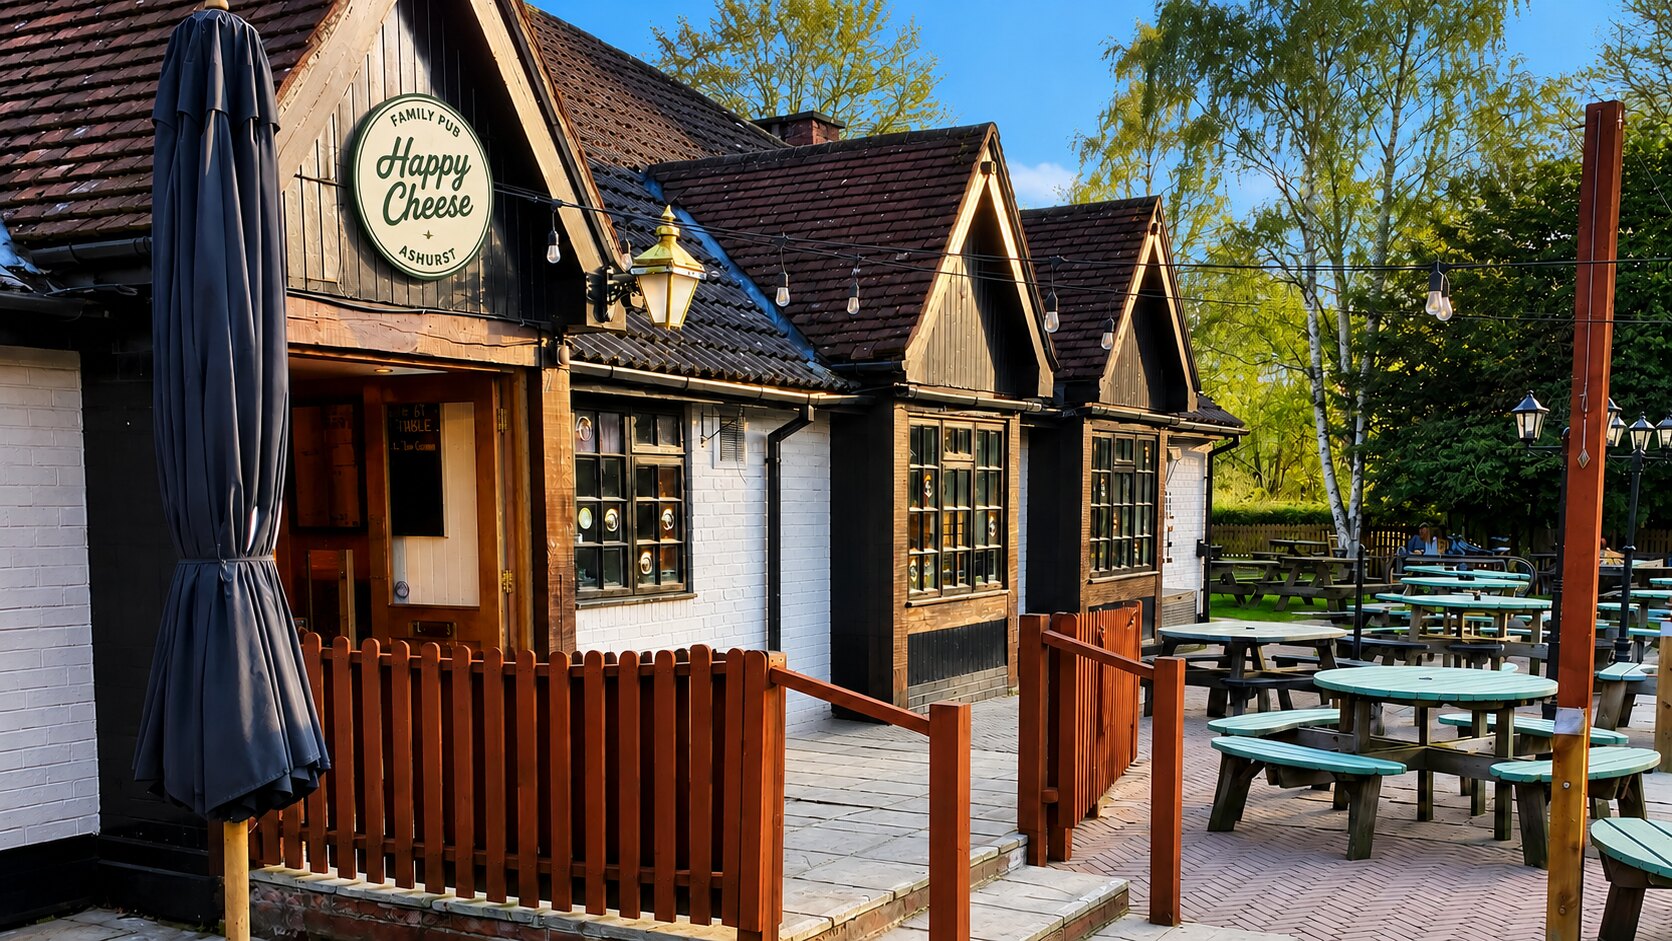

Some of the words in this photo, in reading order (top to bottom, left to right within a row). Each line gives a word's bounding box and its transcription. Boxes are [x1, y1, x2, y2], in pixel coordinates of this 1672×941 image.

[390, 107, 435, 128] FAMILY
[437, 114, 461, 138] PUB
[376, 136, 472, 191] Happy
[382, 181, 474, 226] Cheese
[398, 245, 456, 267] ASHURST
